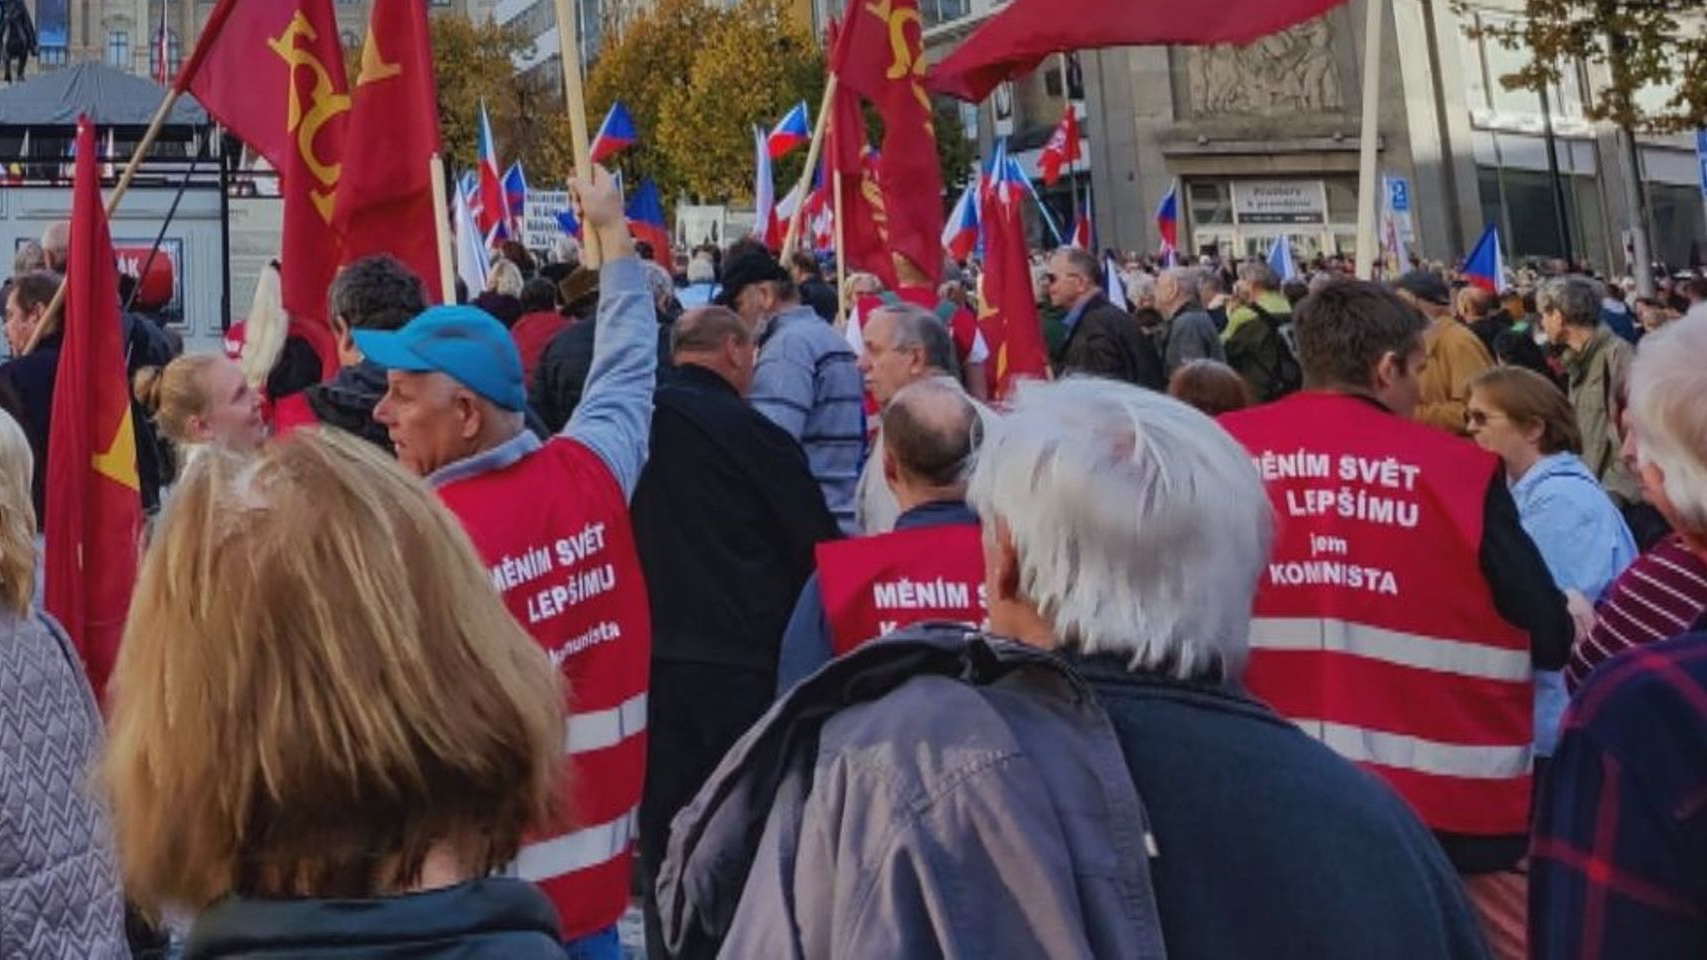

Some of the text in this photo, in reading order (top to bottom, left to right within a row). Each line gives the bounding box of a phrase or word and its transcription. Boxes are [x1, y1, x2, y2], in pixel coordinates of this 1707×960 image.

[1338, 454, 1421, 491] SVĚT
[1286, 485, 1420, 527] LEPŠÍMU
[527, 563, 616, 624] LEPŠÍMU
[873, 575, 970, 609] MĚNÍM
